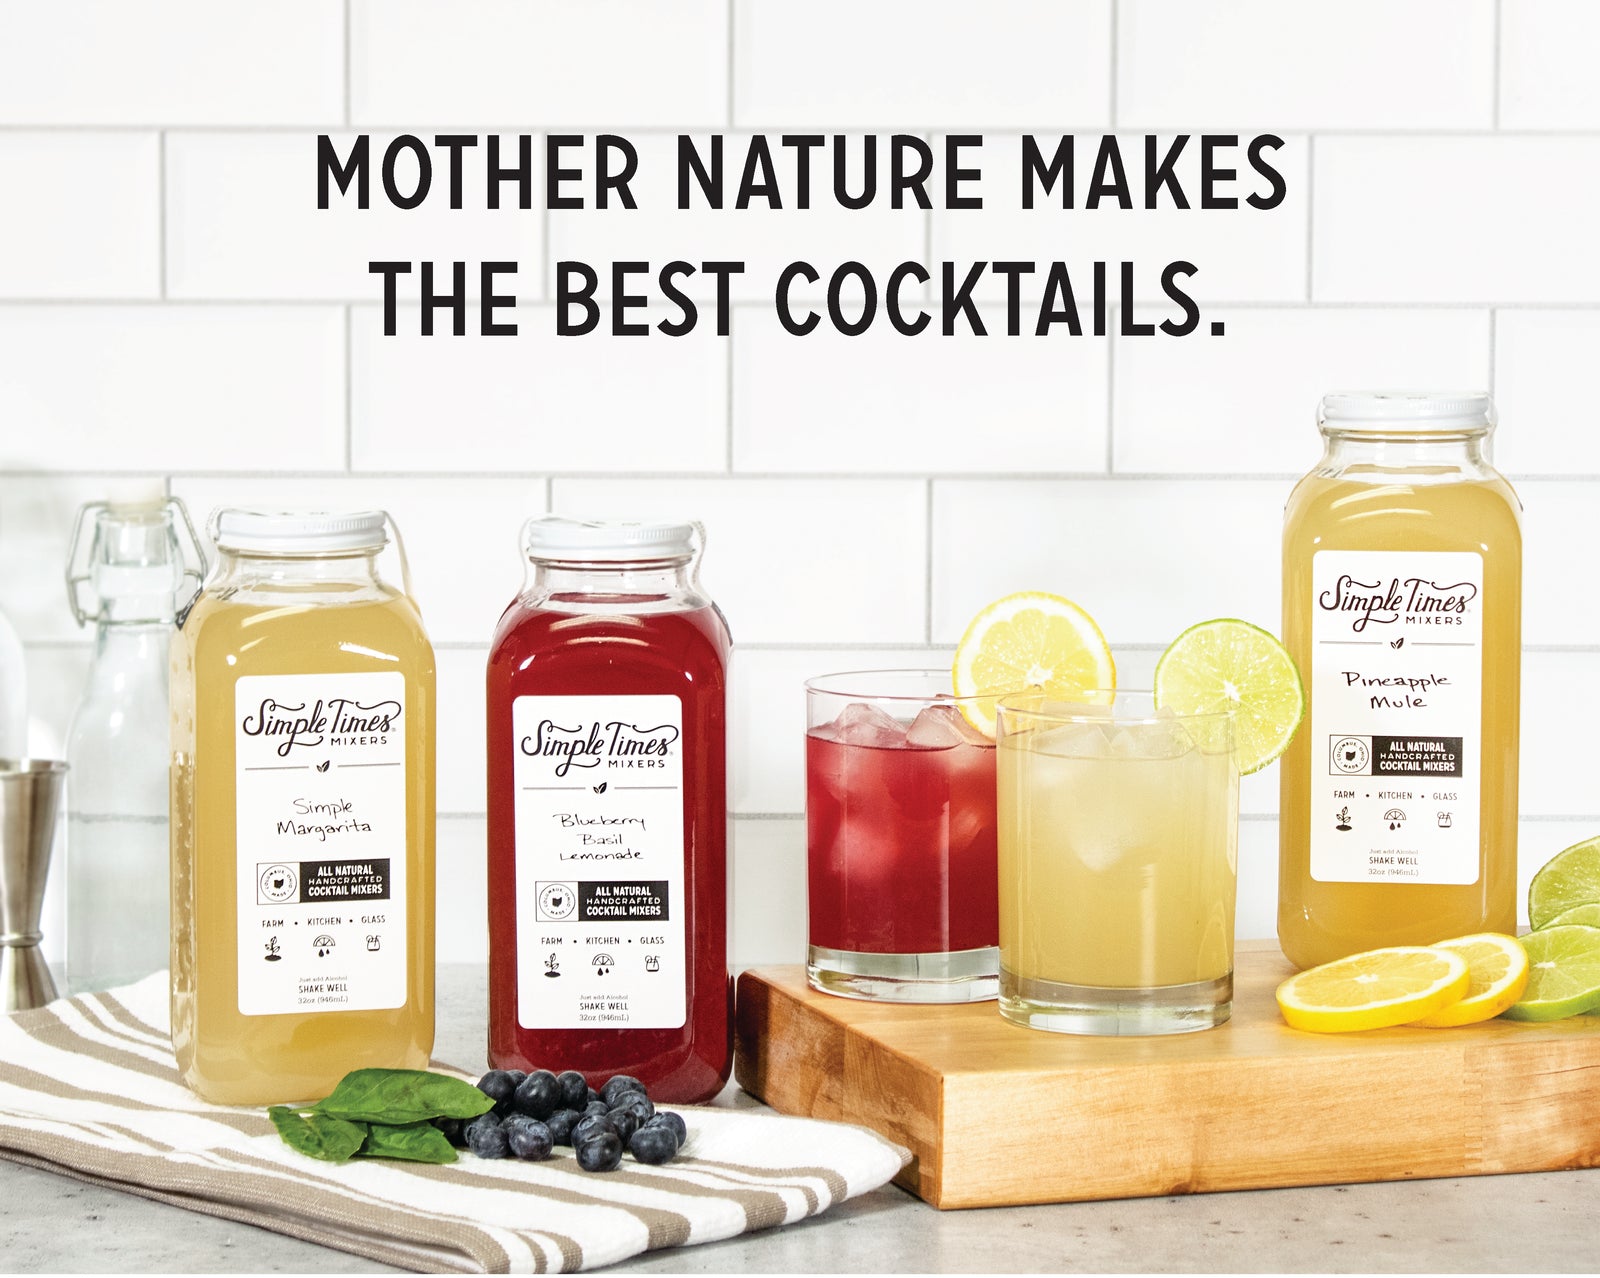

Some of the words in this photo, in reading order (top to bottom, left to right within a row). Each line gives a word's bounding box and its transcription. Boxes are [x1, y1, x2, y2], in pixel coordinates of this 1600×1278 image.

[1319, 574, 1403, 633] Simple
[1403, 578, 1477, 614] Times
[1405, 616, 1462, 625] MIXERS
[1341, 671, 1452, 692] Pineapple
[1370, 695, 1428, 709] Mule
[242, 698, 327, 757] Simple
[328, 698, 402, 734] Times
[330, 736, 388, 746] MIXERS
[521, 719, 605, 778] Simple
[605, 721, 679, 756] Times
[1390, 741, 1405, 752] ALL
[1407, 742, 1446, 753] NATURAL
[1380, 753, 1455, 761] HANDCRAFTED
[608, 760, 665, 768] MIXERS
[1380, 761, 1421, 771] COCKTAIL
[1423, 761, 1455, 772] MIXERS
[1334, 791, 1355, 799] FARM
[1378, 792, 1413, 800] KITCHEN
[1433, 792, 1458, 800] GLASS
[292, 798, 352, 819] Simple
[552, 814, 646, 831] Blueberry
[277, 819, 372, 842] Margarita
[577, 834, 623, 846] Basil
[560, 848, 644, 861] Lemonade
[1369, 857, 1394, 865] SHAKE
[1397, 857, 1419, 866] WELL
[317, 866, 333, 877] ALL
[335, 864, 373, 876] NATURAL
[1368, 868, 1386, 876] 32oz
[308, 876, 383, 885] HANDCRAFTED
[308, 885, 349, 897] COCKTAIL
[351, 884, 383, 895] MIXERS
[595, 886, 611, 896] ALL
[613, 886, 652, 896] NATURAL
[587, 897, 661, 905] HANDCRAFTED
[587, 906, 627, 916] COCKTAIL
[629, 906, 661, 916] MIXERS
[262, 920, 284, 928] FARM
[308, 918, 342, 926] KITCHEN
[361, 915, 386, 924] GLASS
[541, 937, 563, 945] FARM
[586, 937, 620, 945] KITCHEN
[640, 937, 665, 945] GLASS
[299, 985, 324, 994] SHAKE
[327, 984, 348, 992] WELL
[579, 1002, 605, 1010] SHAKE
[607, 1002, 628, 1010] WELL
